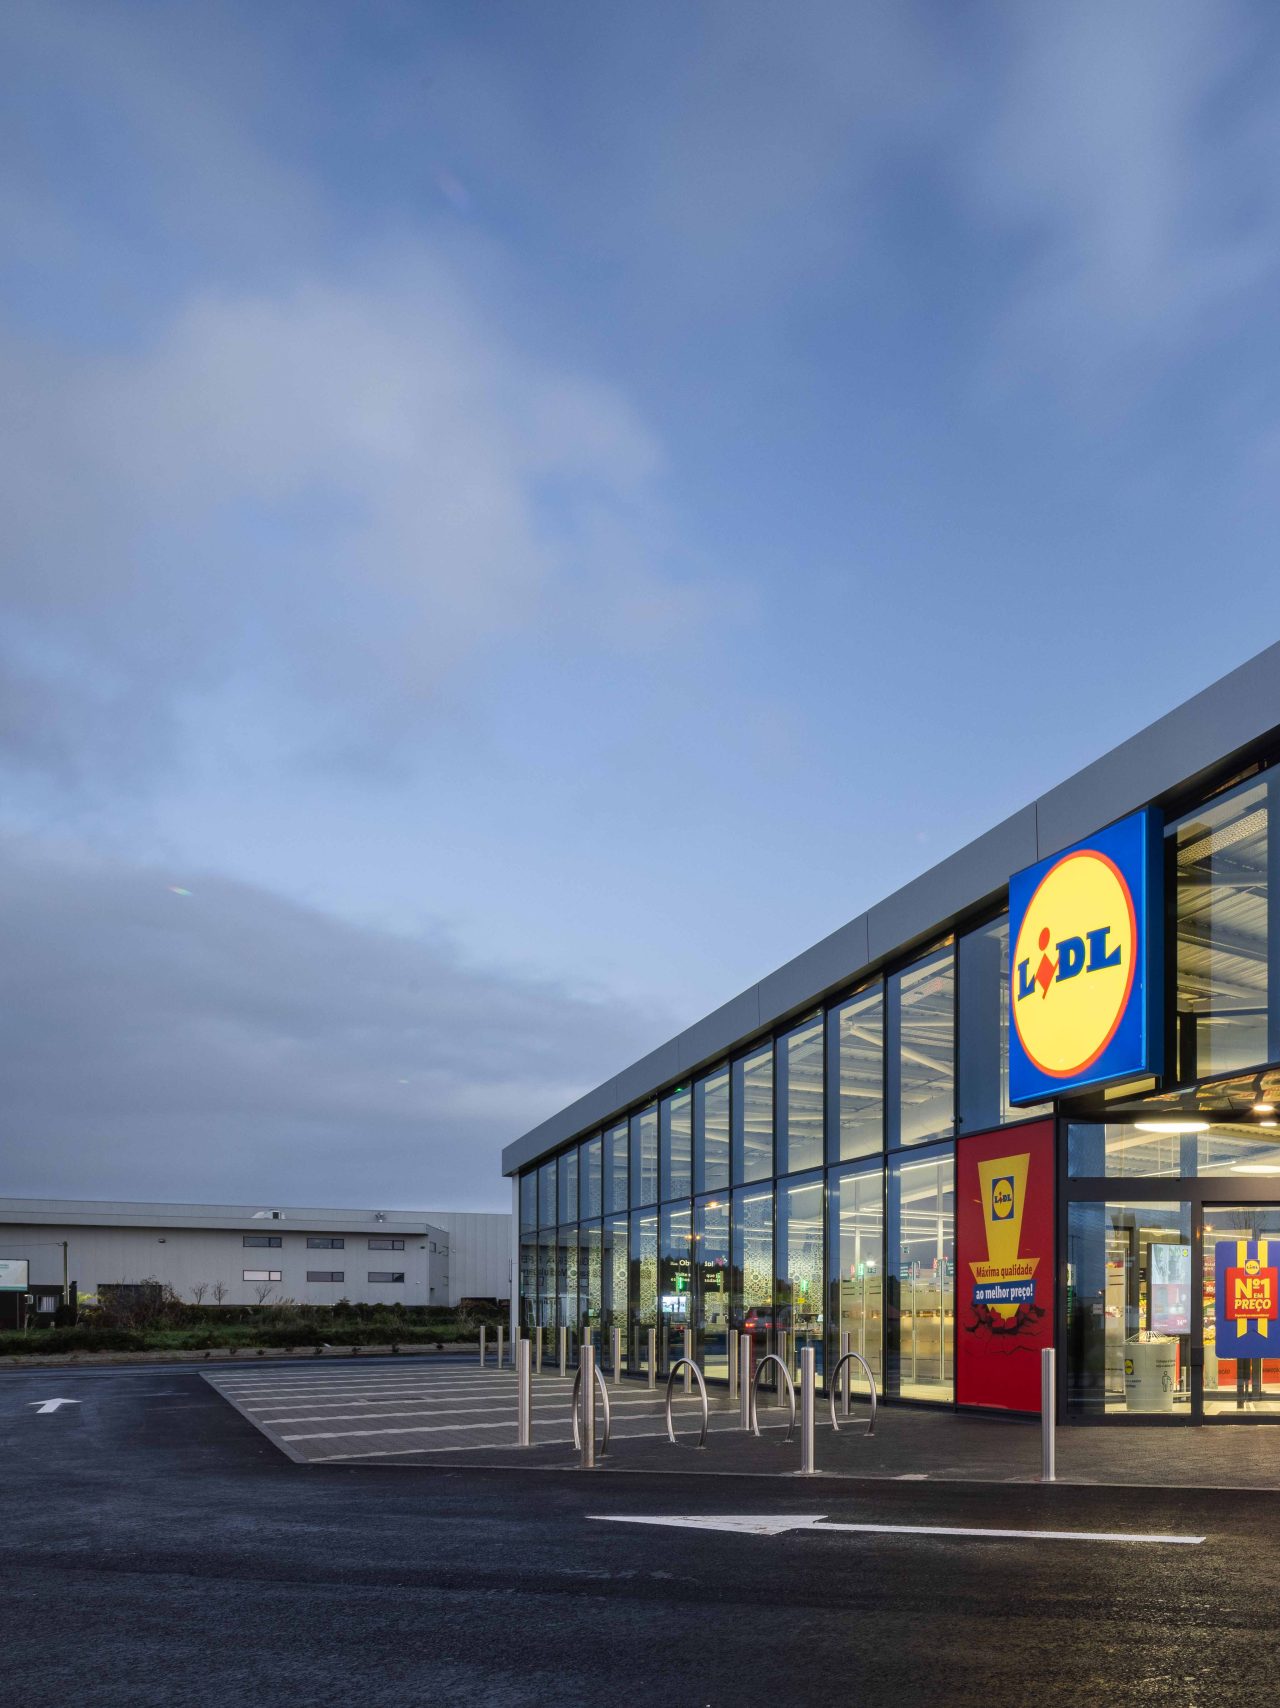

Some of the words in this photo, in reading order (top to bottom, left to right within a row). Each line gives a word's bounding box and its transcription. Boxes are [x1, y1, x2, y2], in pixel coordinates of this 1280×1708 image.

[976, 1266, 1000, 1278] Máxima
[1001, 1263, 1033, 1280] qualidade
[976, 1290, 984, 1300] ao
[985, 1285, 1009, 1299] melhor
[1010, 1283, 1033, 1301] preço!
[1234, 1299, 1272, 1312] PREÇO
